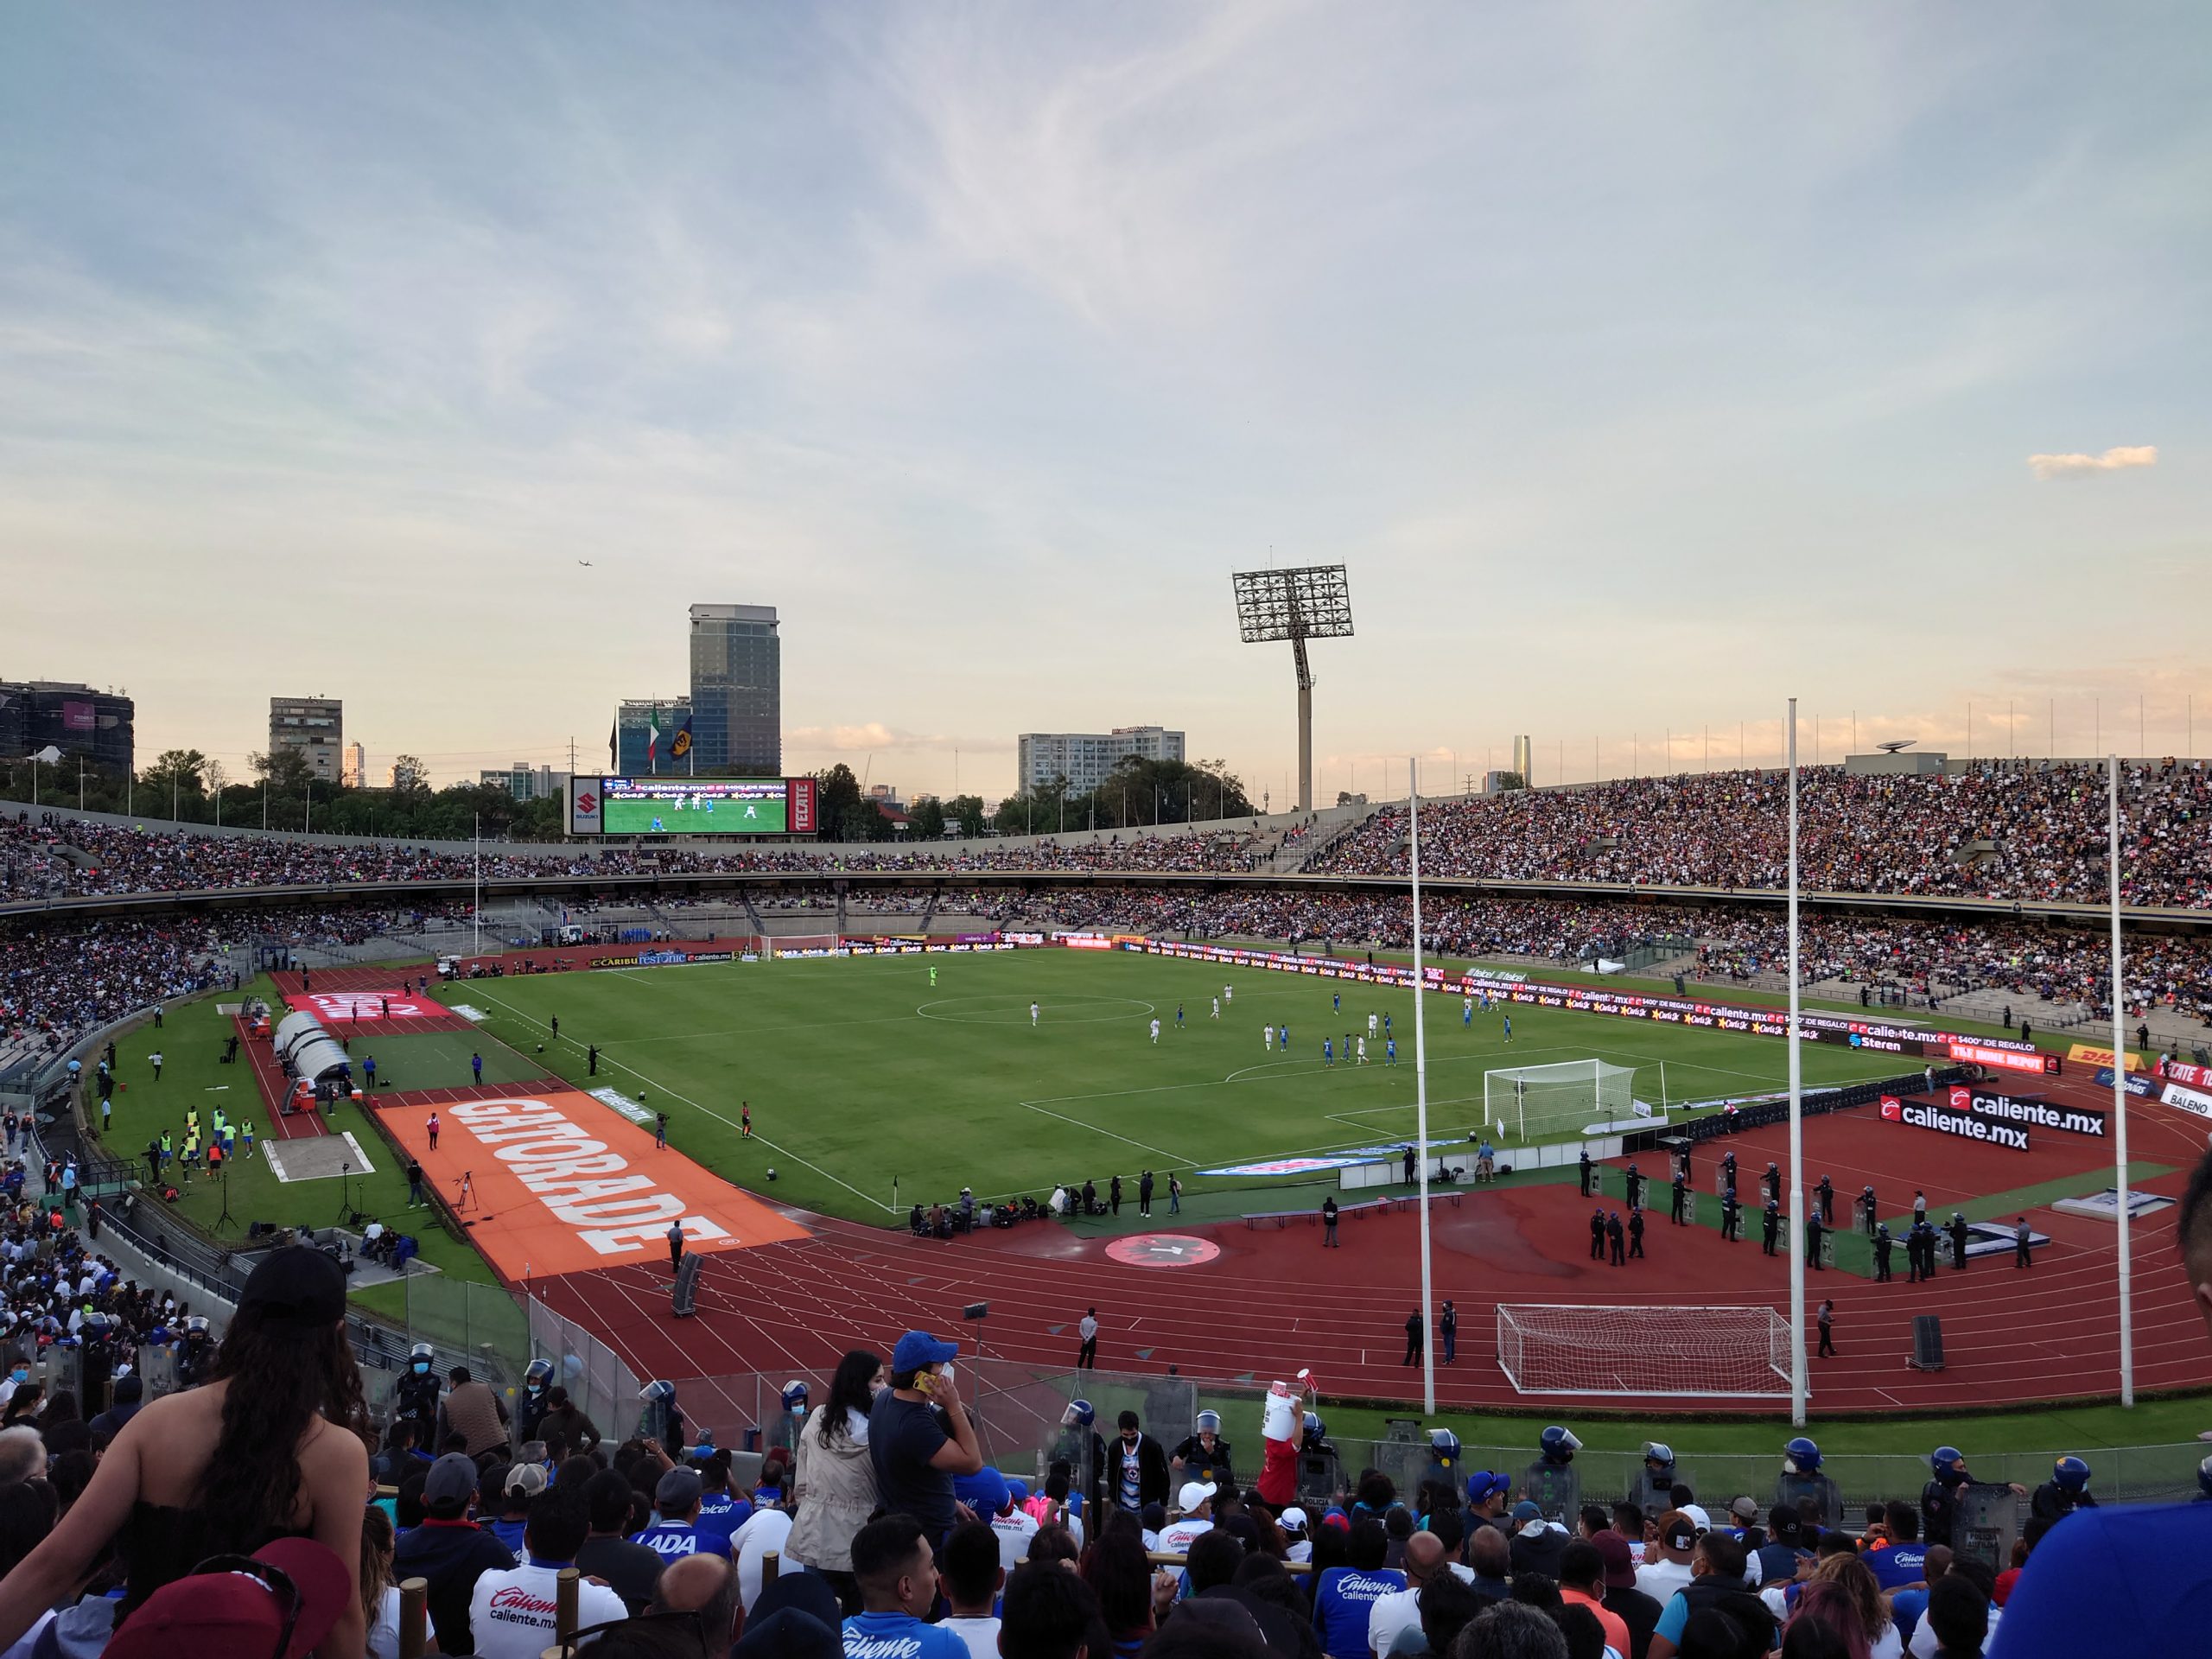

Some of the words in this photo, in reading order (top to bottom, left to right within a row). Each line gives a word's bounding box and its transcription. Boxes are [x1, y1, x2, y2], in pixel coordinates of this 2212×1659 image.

[796, 784, 809, 830] TECATE
[601, 957, 638, 966] CARIBU
[695, 953, 731, 962] caliente.mx
[1278, 956, 1306, 964] caliente.mx
[1473, 969, 1495, 978] telcel
[1503, 972, 1527, 982] telcel
[1473, 978, 1513, 990] caliente.mx
[1581, 992, 1629, 1004] calient.mx
[1711, 1007, 1768, 1022] caliente.mx
[1817, 1019, 1847, 1029] REGALO!
[1867, 1026, 1937, 1043] caliete.mx
[1999, 1040, 2035, 1052] REGALO!
[1861, 1037, 1901, 1051] Steren
[2170, 1094, 2208, 1114] BALENO
[1973, 1096, 2103, 1135] caliente.mx
[1902, 1106, 2028, 1150] caliente.mx
[448, 1099, 732, 1255] GATORADE
[636, 1534, 696, 1554] LADA
[1894, 1551, 1925, 1564] Calien
[1338, 1573, 1397, 1594] Caliente
[490, 1586, 559, 1614] Calien
[1342, 1591, 1380, 1601] caliente
[842, 1626, 922, 1659] aliente
